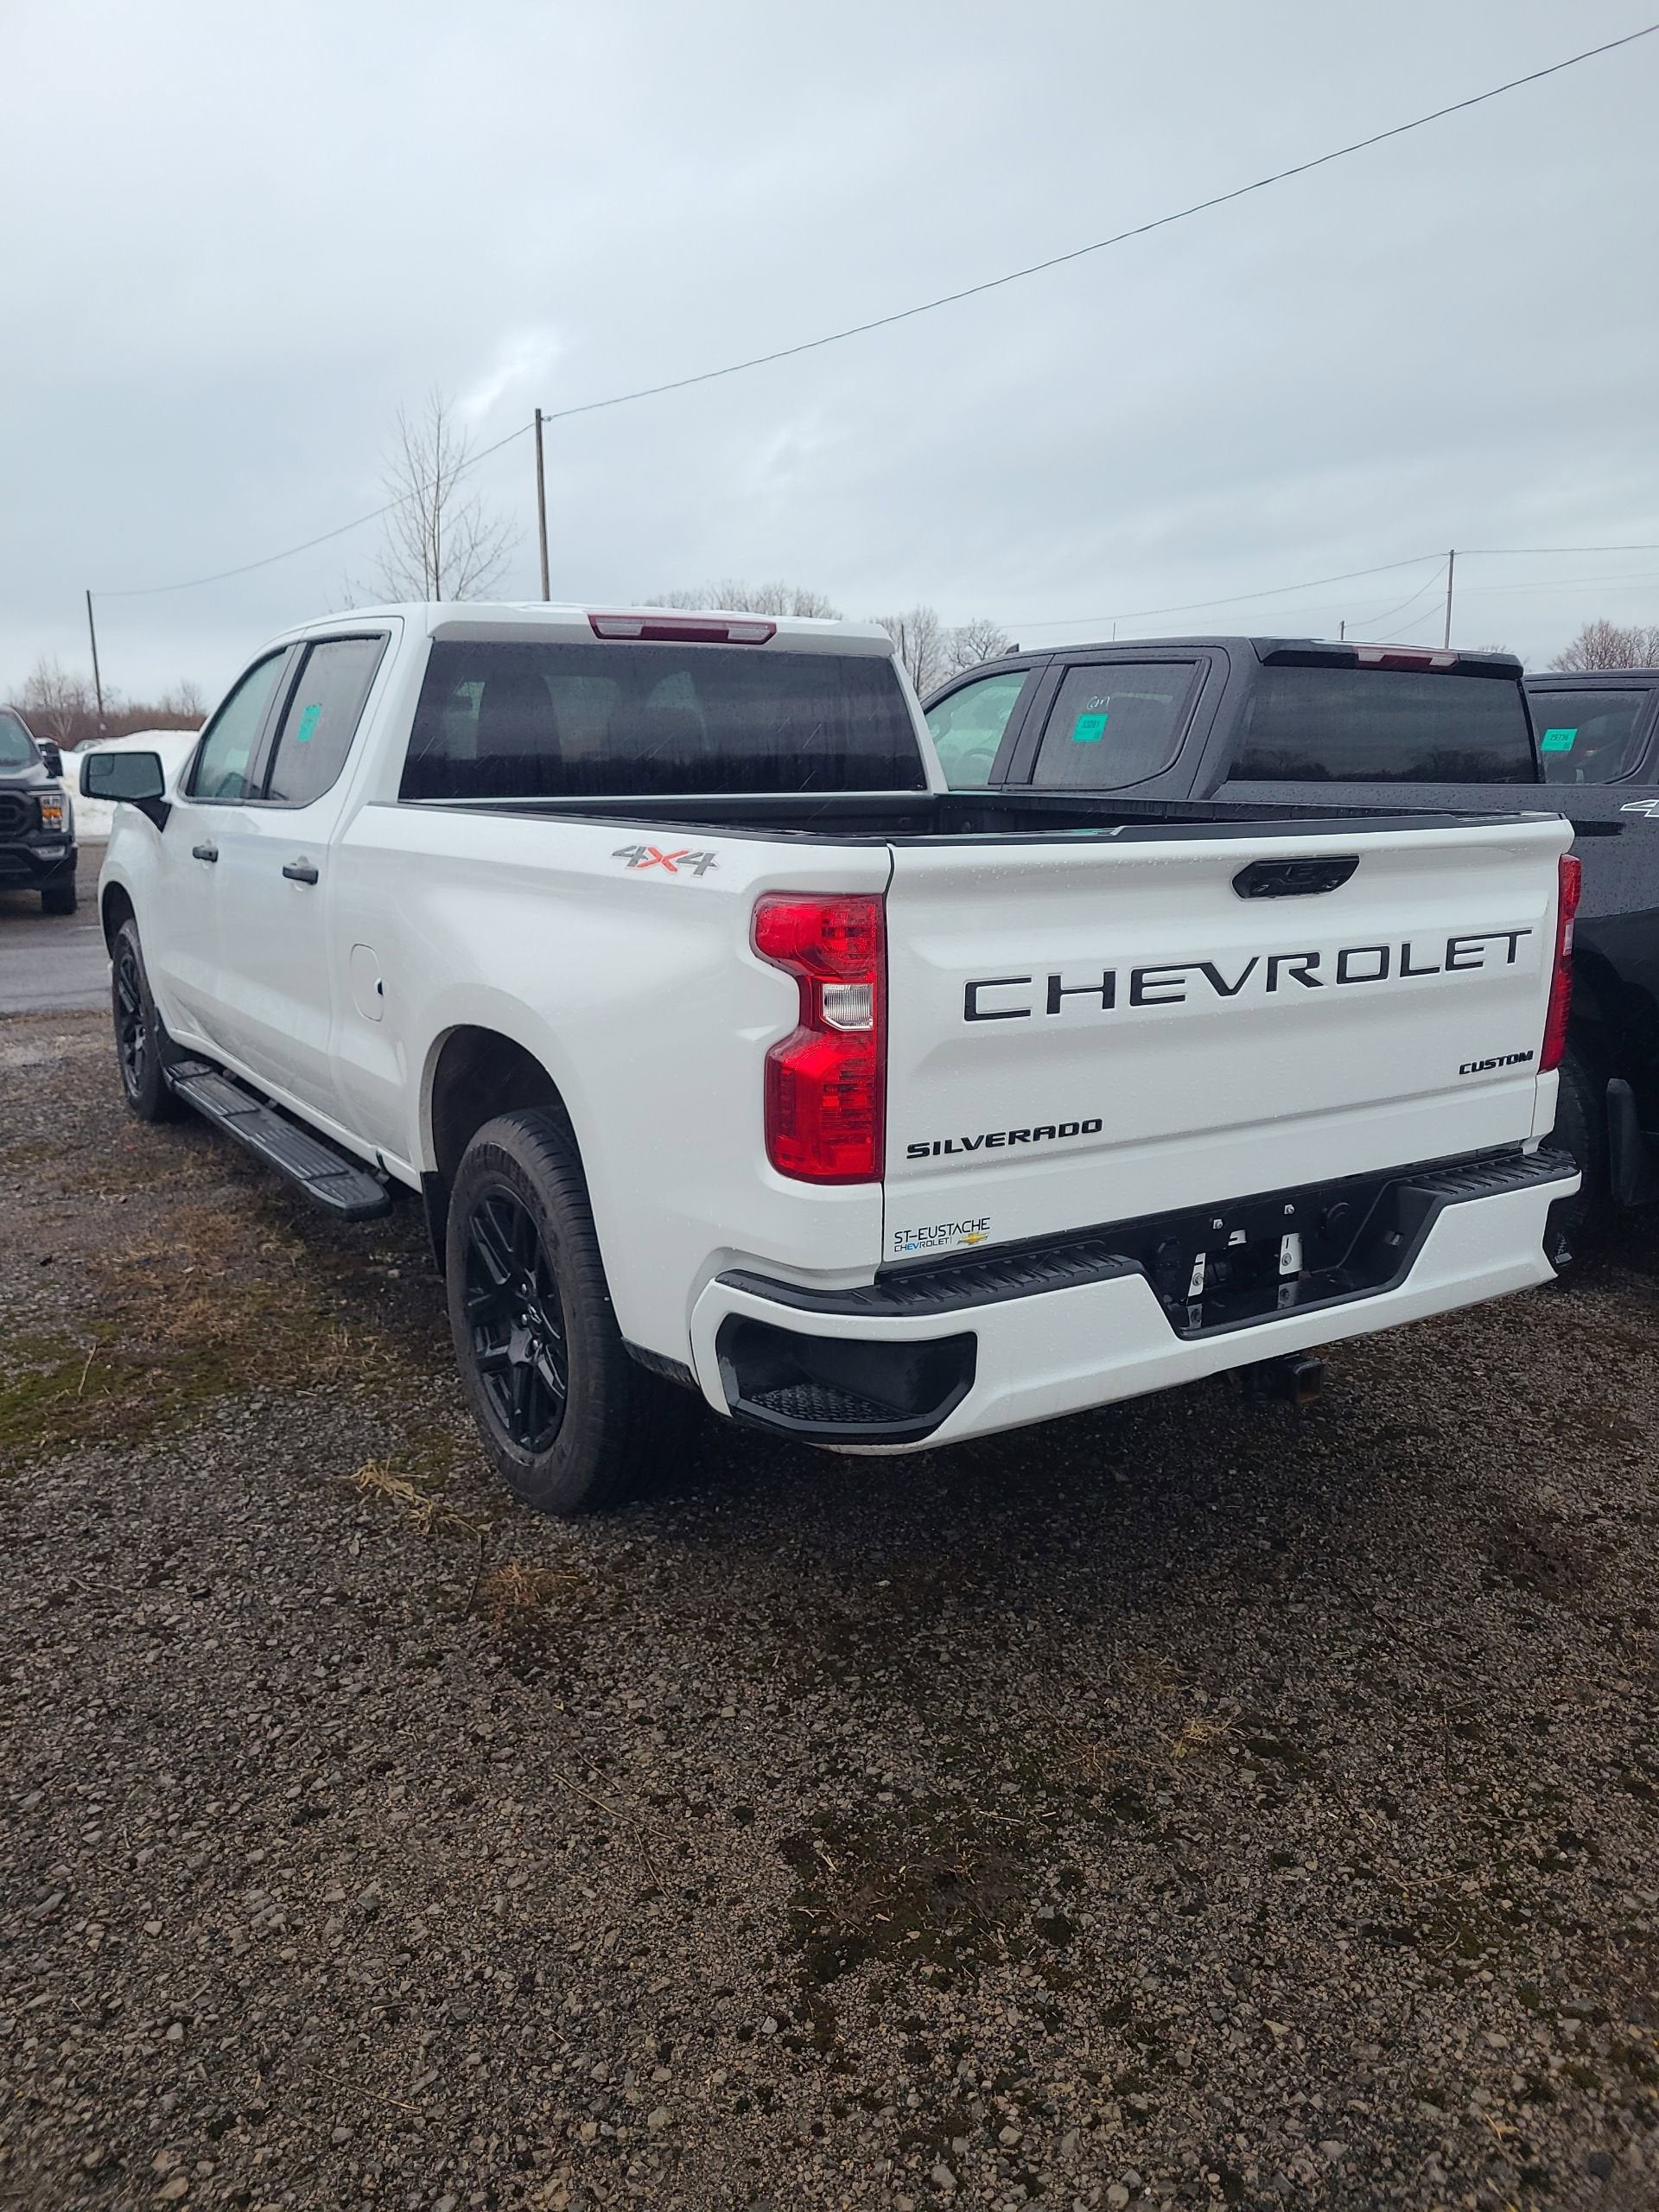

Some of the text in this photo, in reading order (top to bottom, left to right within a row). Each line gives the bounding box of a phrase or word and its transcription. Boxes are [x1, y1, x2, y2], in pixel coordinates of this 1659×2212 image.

[963, 928, 1533, 1022] CHEVROLET
[1459, 1049, 1535, 1075] CUSTOM
[906, 1117, 1103, 1160] SILVERADO
[893, 1217, 991, 1244] ST-EUSTACHE
[893, 1236, 950, 1253] CHEVROLET
